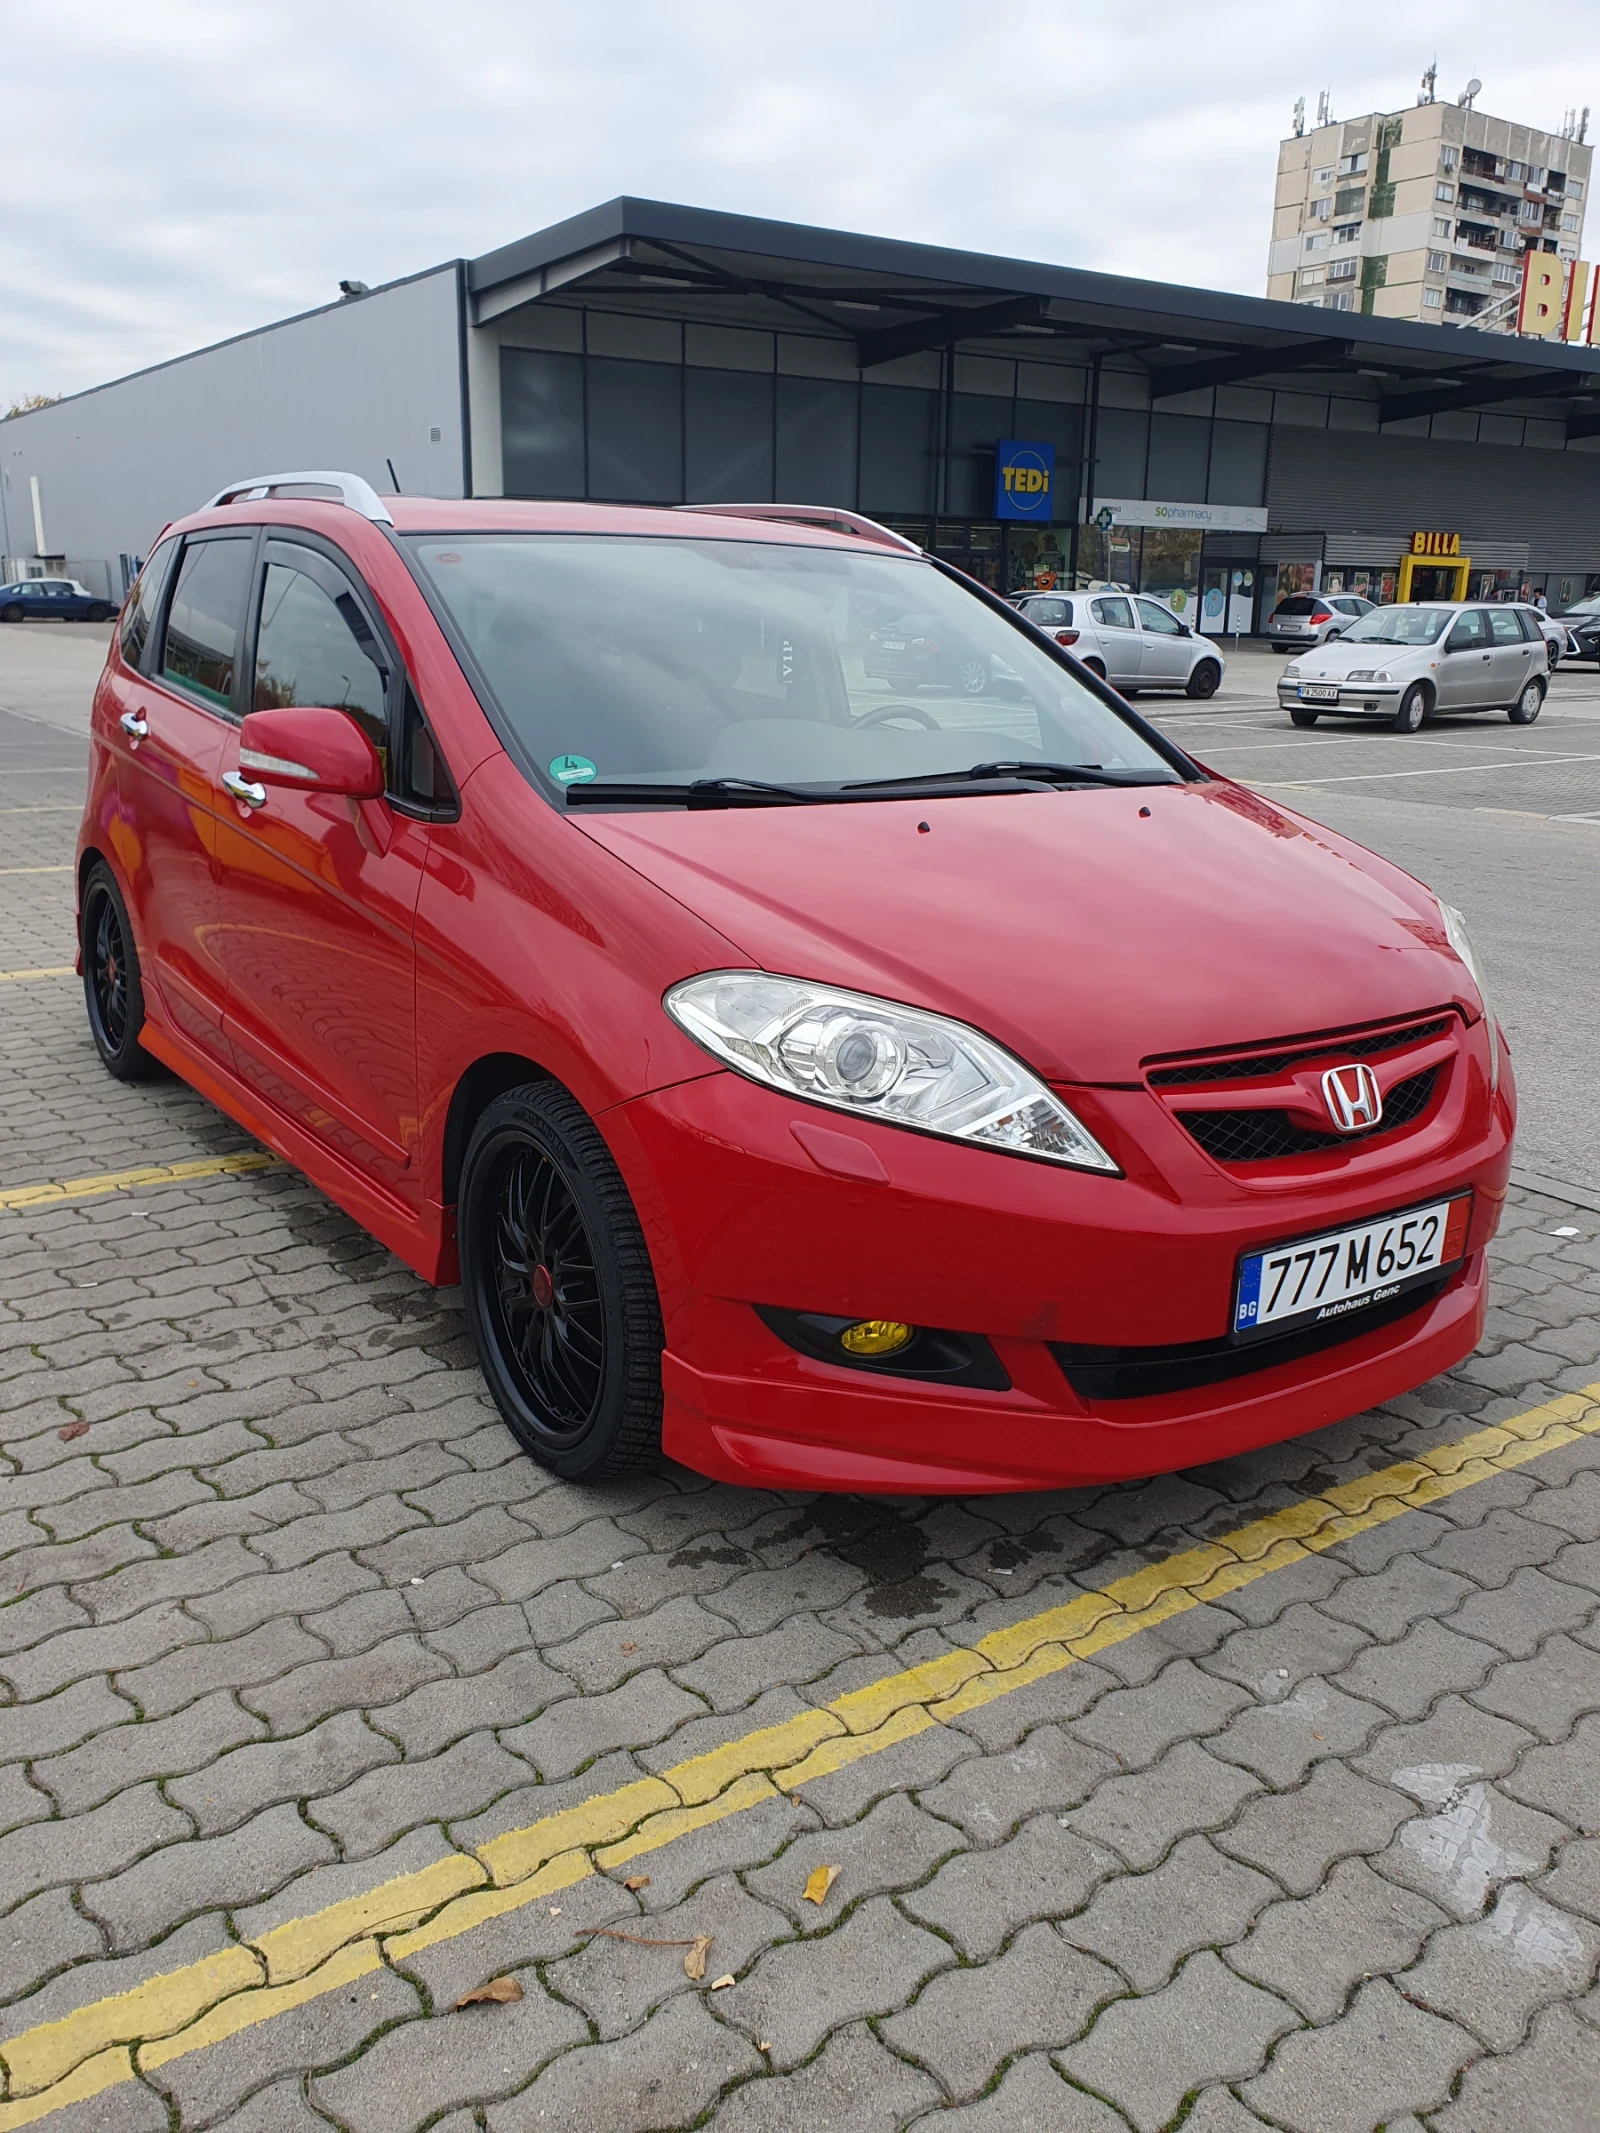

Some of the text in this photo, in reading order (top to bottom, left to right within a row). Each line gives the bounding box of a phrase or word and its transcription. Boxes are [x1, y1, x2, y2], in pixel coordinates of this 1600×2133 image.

[1517, 249, 1600, 344] BI
[1002, 467, 1049, 493] TEDi
[1411, 531, 1460, 555] BILLA
[783, 640, 793, 676] VIP
[1311, 689, 1326, 697] 2500
[564, 756, 578, 769] 4
[1266, 1244, 1340, 1313] 777
[1345, 1234, 1371, 1290] M
[1376, 1215, 1439, 1278] 652
[1238, 1300, 1257, 1320] BG
[1316, 1283, 1401, 1320] Autohaus Genc
